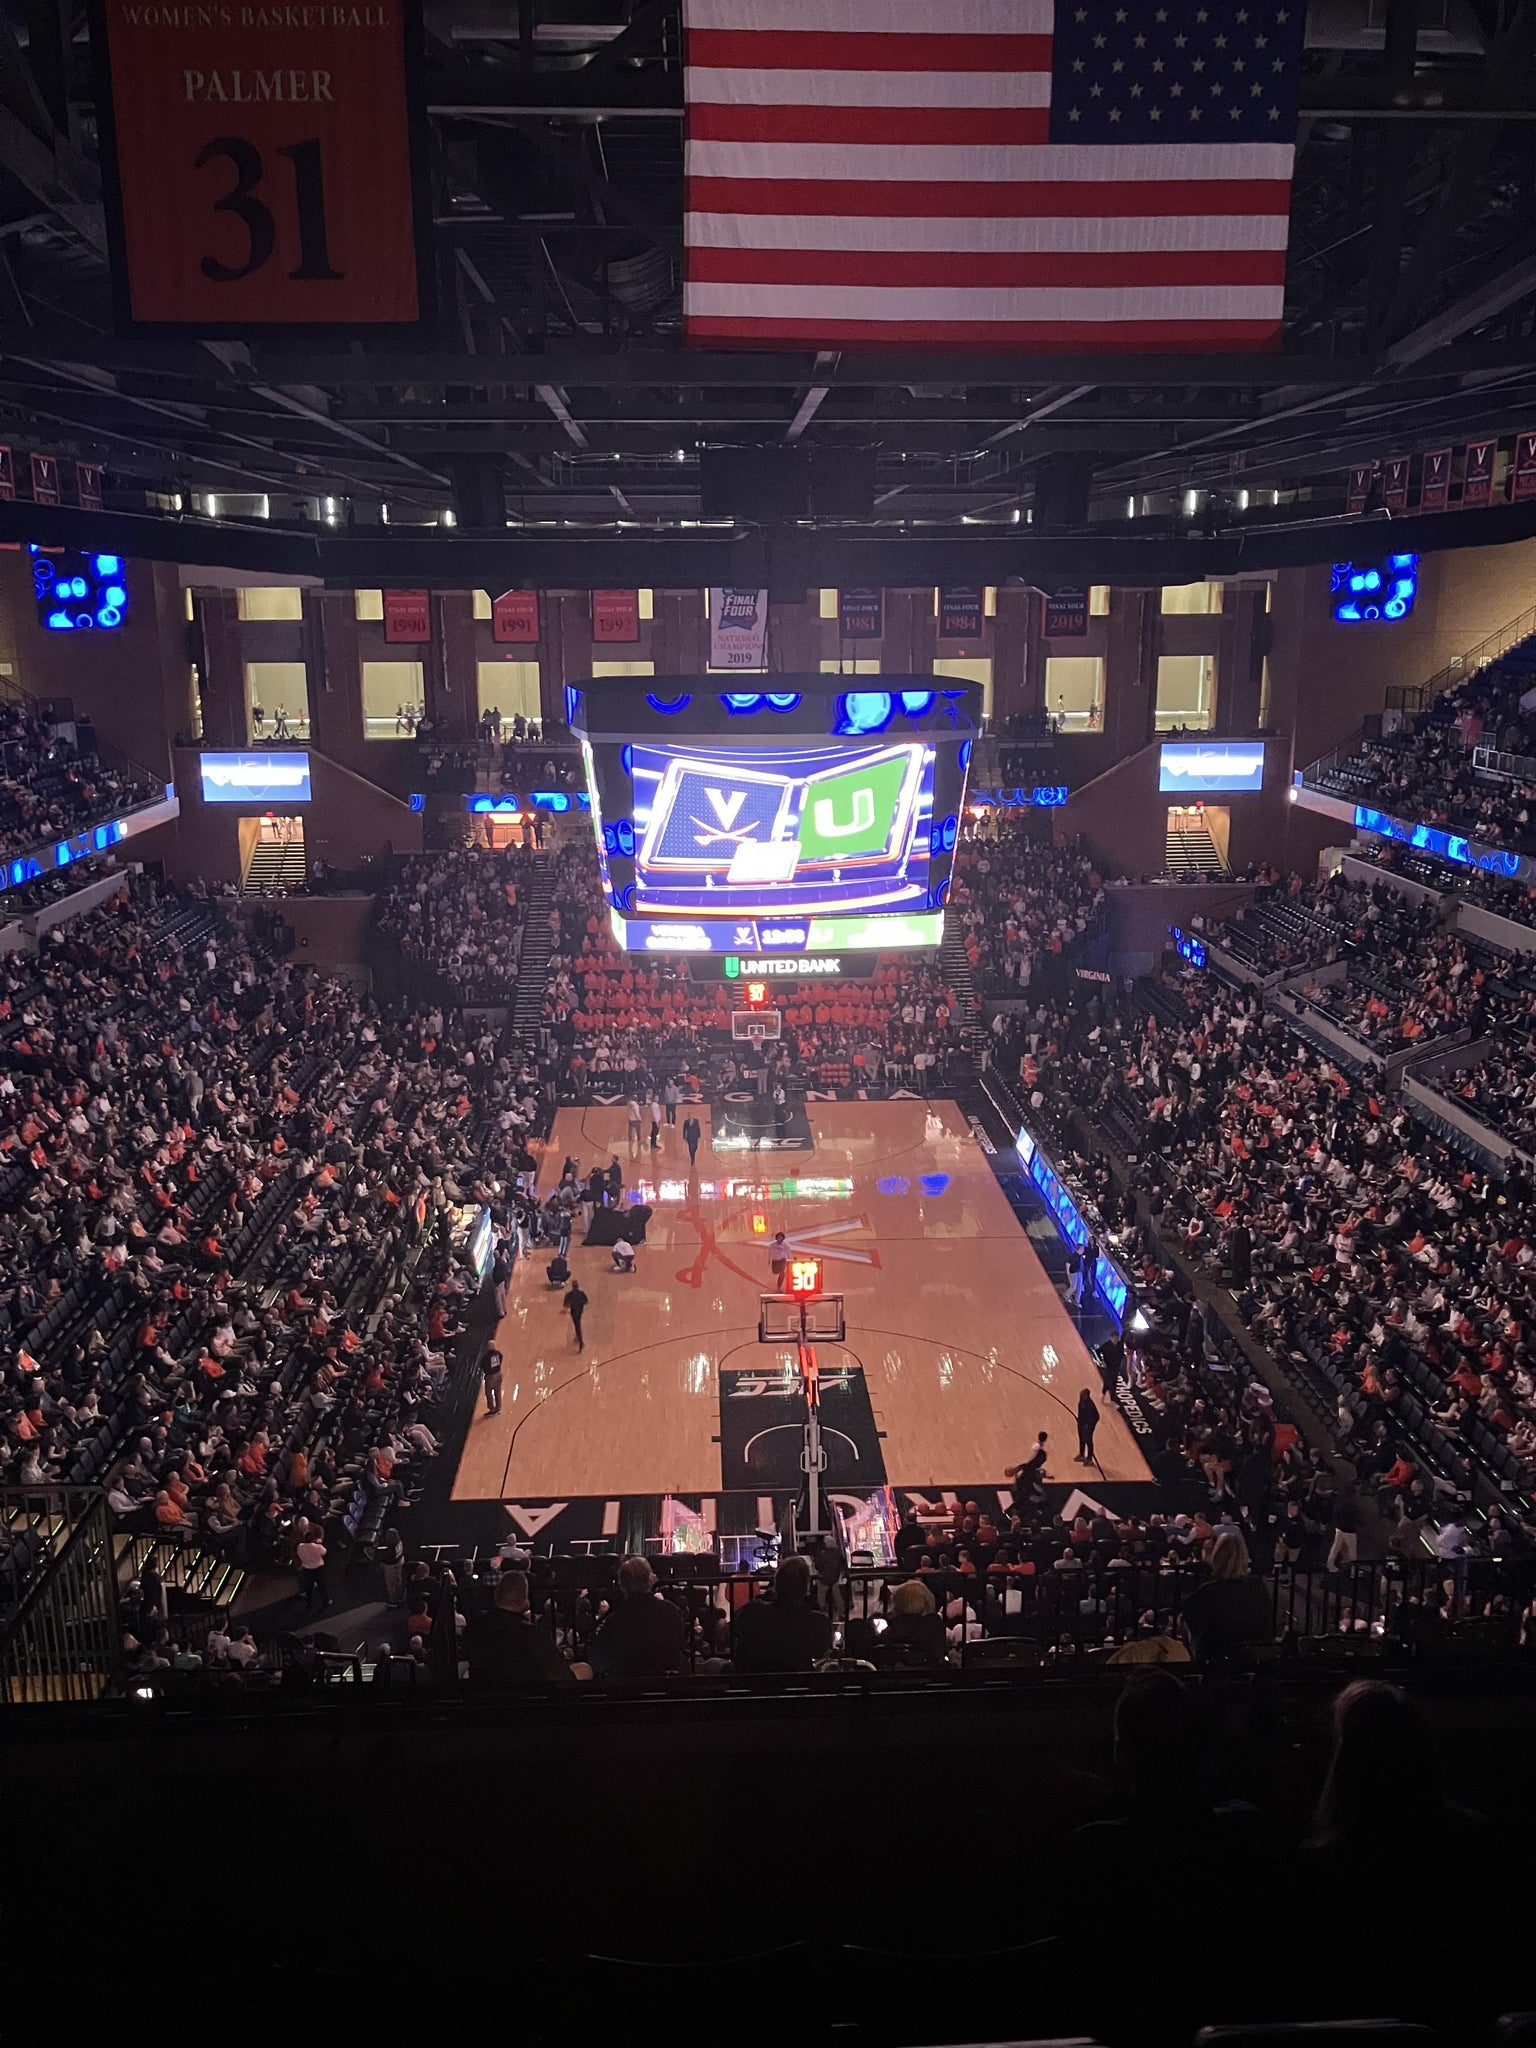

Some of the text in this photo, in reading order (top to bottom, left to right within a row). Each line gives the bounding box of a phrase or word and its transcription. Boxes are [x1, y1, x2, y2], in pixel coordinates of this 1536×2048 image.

[122, 4, 390, 27] WOMEN'S BASKETBALL
[183, 69, 335, 102] PALMER
[194, 135, 346, 282] 31
[726, 594, 757, 605] FINAL
[724, 605, 754, 617] FOUR
[501, 618, 532, 632] 1991
[1051, 614, 1084, 629] 2019
[727, 653, 752, 664] 2019
[703, 787, 748, 831] V
[814, 787, 875, 838] U
[741, 959, 840, 974] UNITED BANK
[591, 1088, 924, 1105] VRGNIA
[792, 1273, 815, 1291] 30
[1115, 1374, 1153, 1434] THOPEDICS
